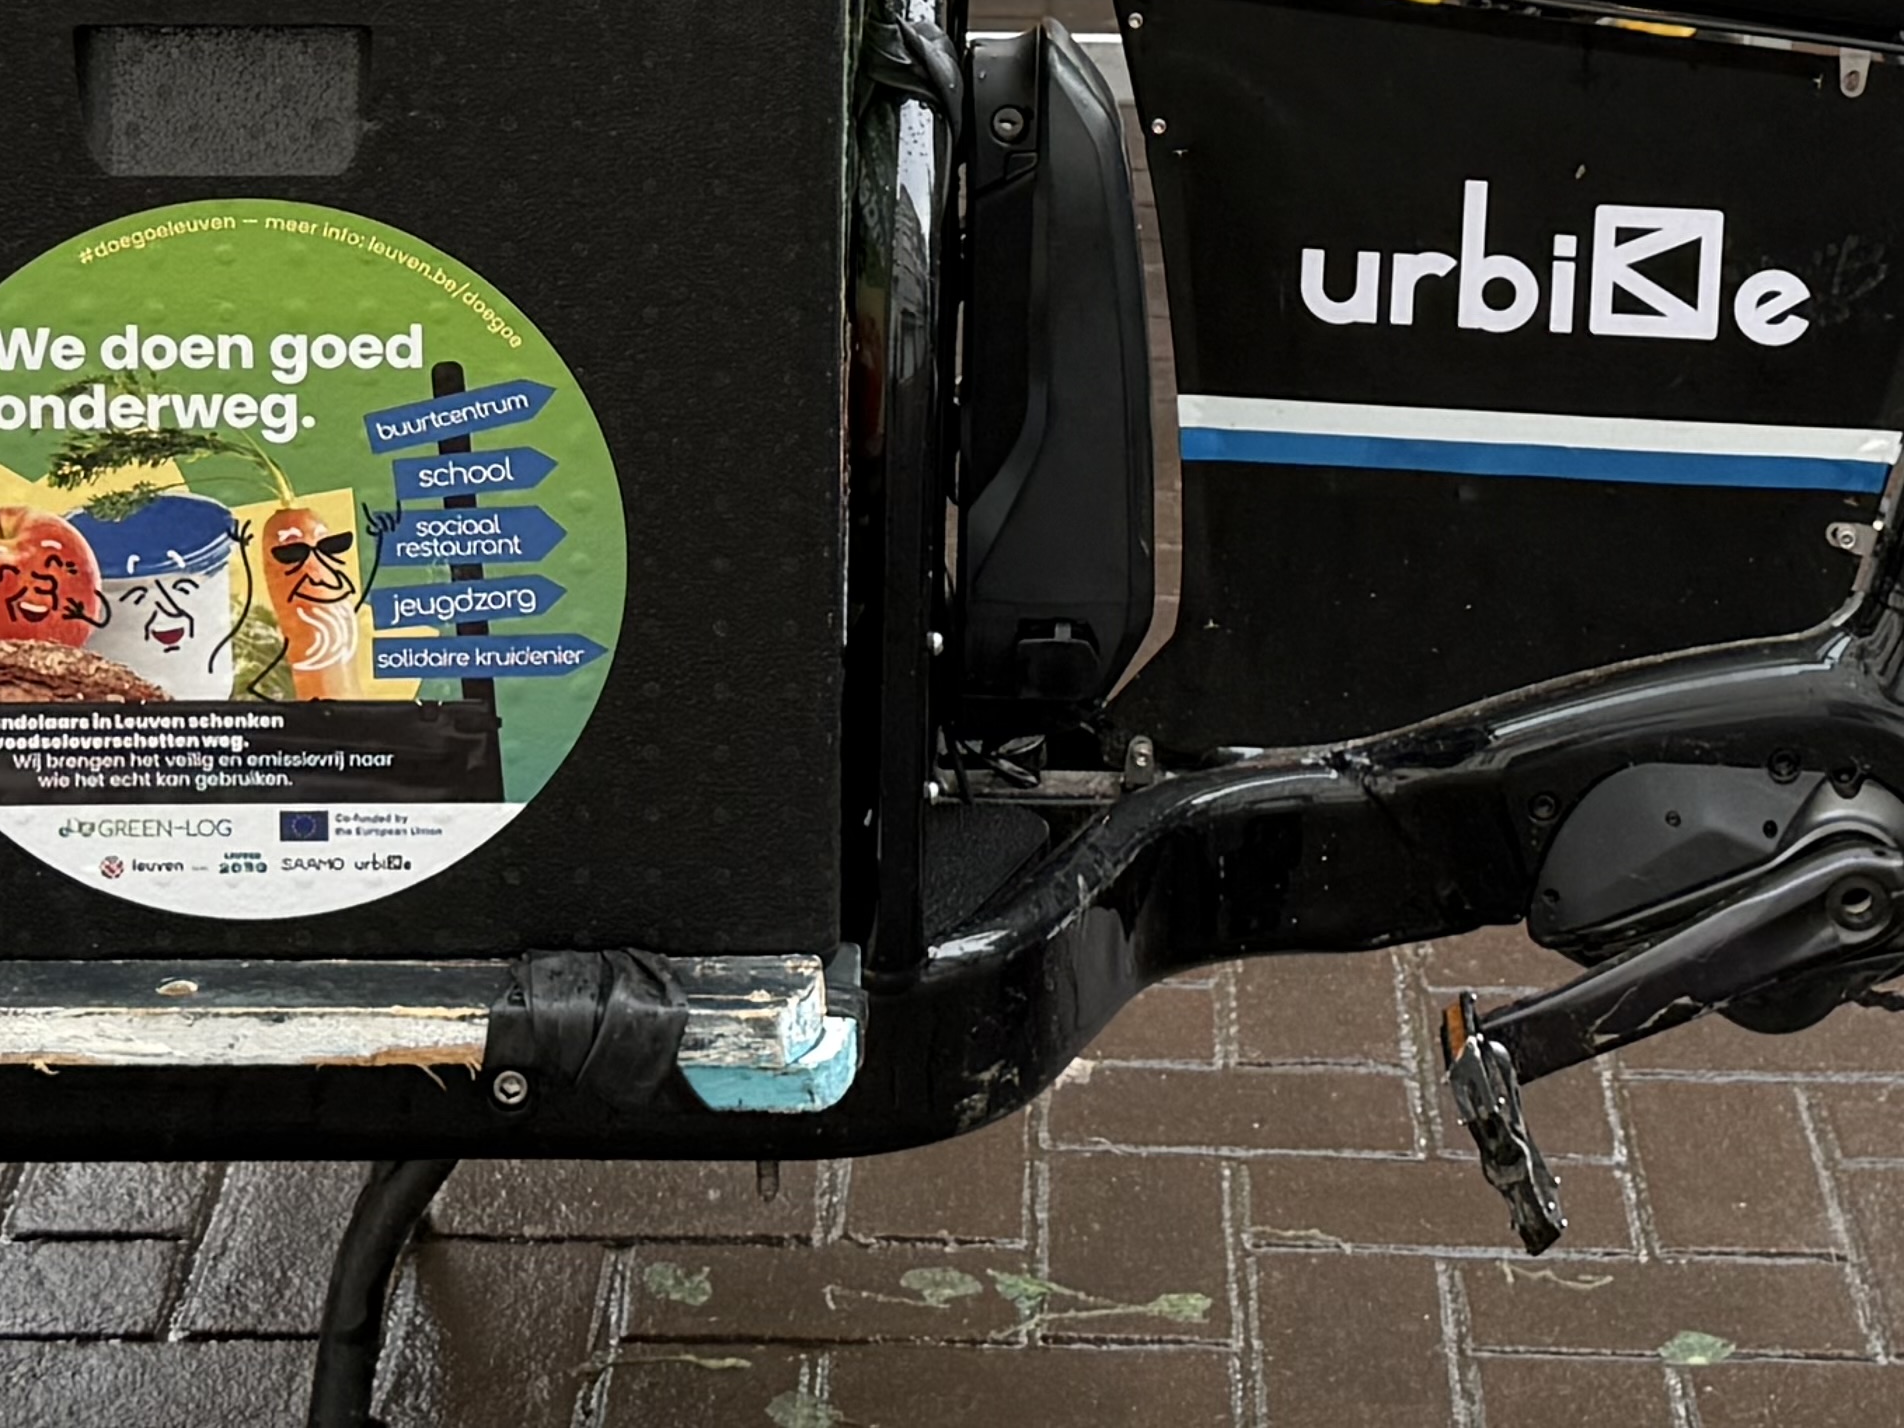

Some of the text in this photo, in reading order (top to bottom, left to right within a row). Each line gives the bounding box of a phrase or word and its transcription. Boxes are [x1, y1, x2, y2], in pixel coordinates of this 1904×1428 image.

[265, 216, 318, 235] meer
[322, 221, 366, 250] info:
[367, 237, 523, 349] leuven.be/doegoe
[100, 325, 255, 370] doen
[269, 323, 425, 384] goed
[376, 393, 529, 441] buurtcentrum
[418, 456, 515, 488] school
[415, 514, 502, 538] sociaal
[396, 535, 523, 558] restaurant
[391, 587, 537, 625] jeugdzorg
[377, 646, 586, 669] solidaire kruidenier
[92, 712, 112, 730] in
[114, 714, 185, 730] Leuven
[188, 712, 285, 729] schenken
[201, 735, 250, 753] weg.
[13, 750, 395, 773] Wij brengen het veilig en emissievrij naar
[37, 771, 294, 791] wie het echt kan gebruiken.
[97, 818, 233, 838] GREEN-LOG
[334, 813, 408, 825] Co-funded by
[334, 827, 353, 836] the
[356, 827, 408, 837] European
[132, 859, 184, 872] leuven
[281, 857, 345, 871] SAAMO
